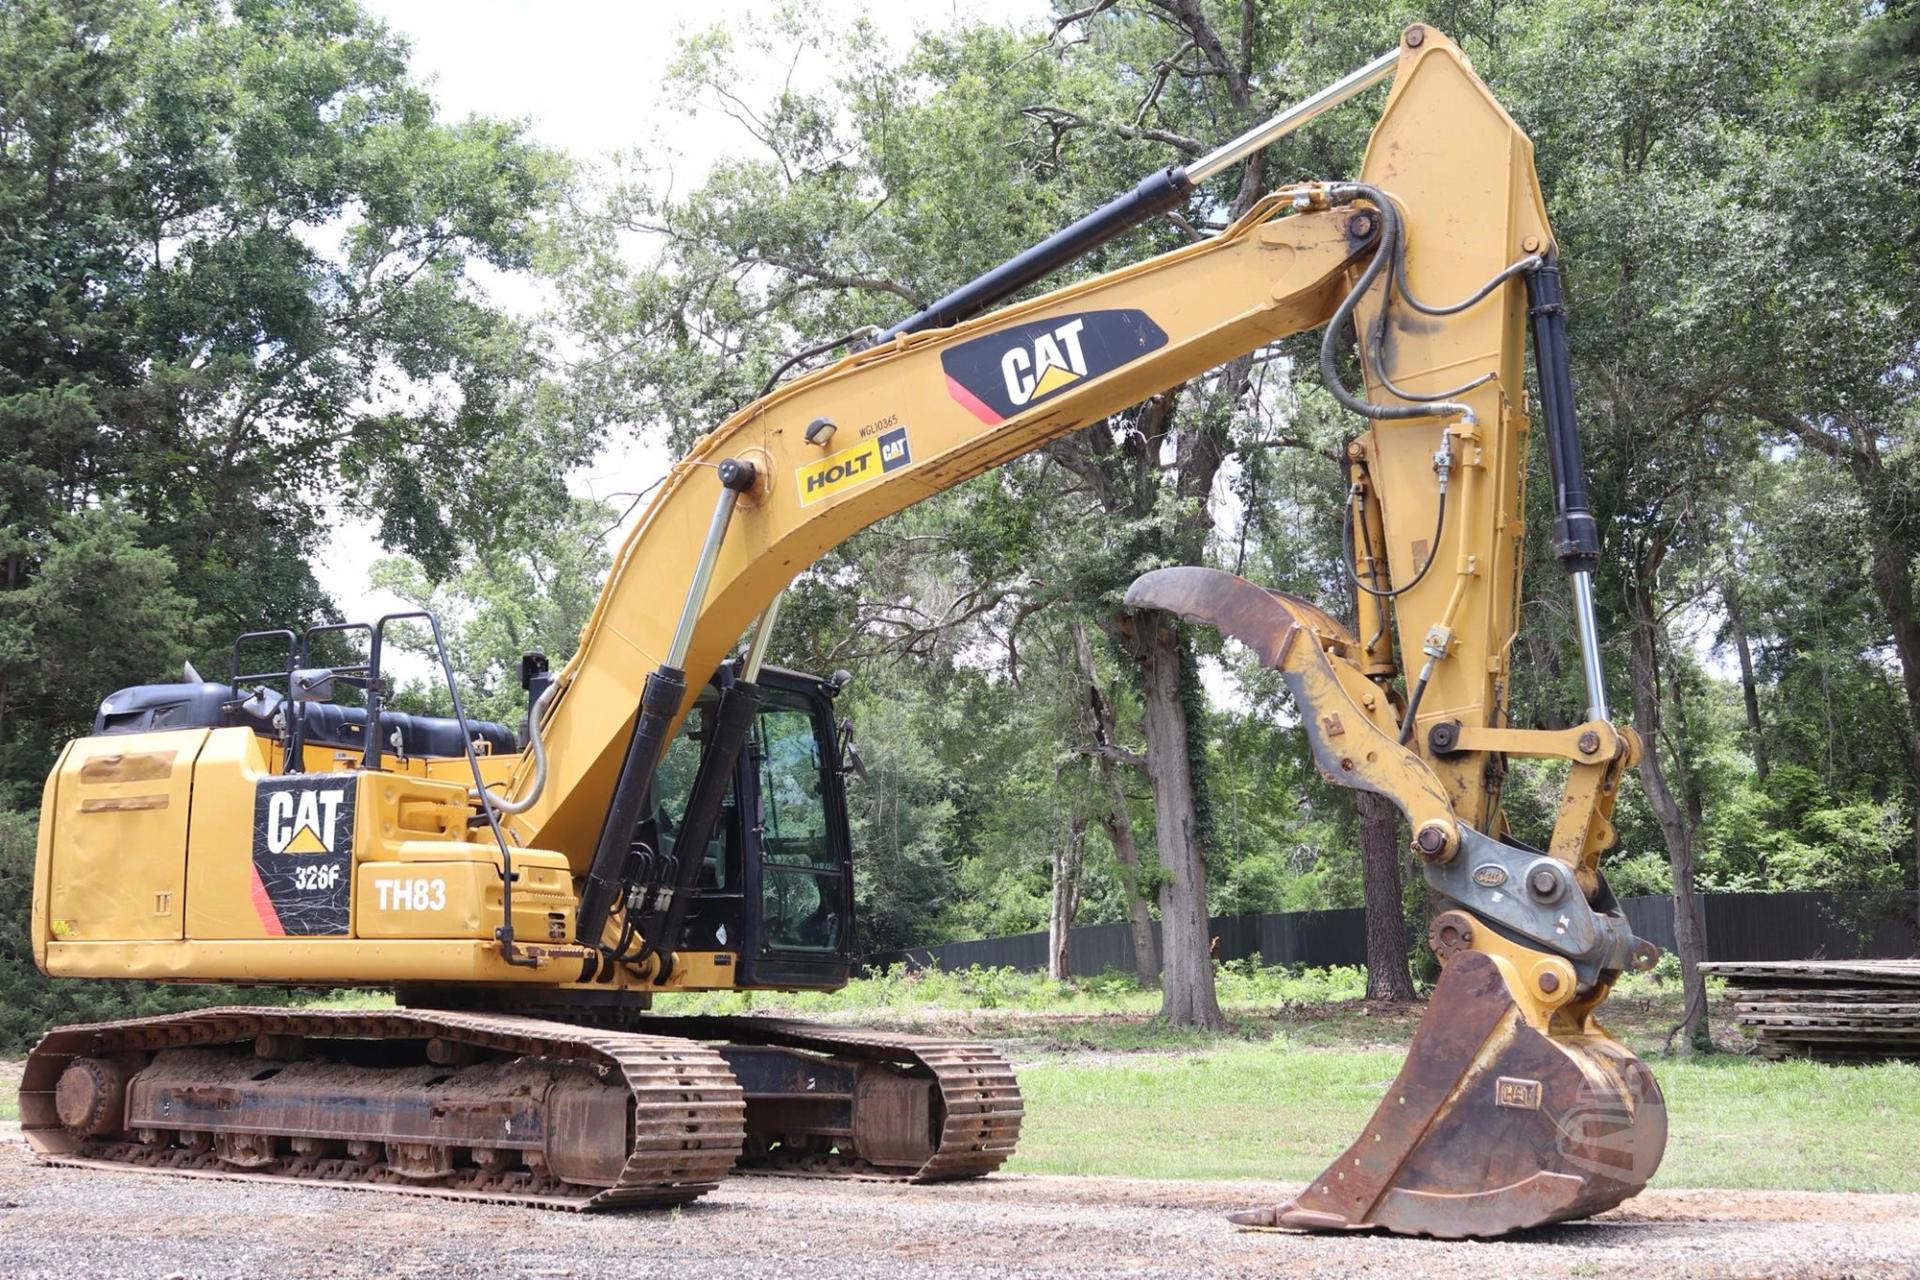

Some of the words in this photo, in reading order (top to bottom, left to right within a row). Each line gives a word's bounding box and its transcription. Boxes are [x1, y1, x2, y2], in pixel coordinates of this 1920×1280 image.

[1001, 318, 1088, 406] CAT
[807, 450, 872, 493] HOLT
[882, 438, 906, 462] CAT
[267, 790, 344, 854] CAT
[295, 865, 340, 890] 326F
[375, 879, 446, 911] TH83
[1501, 1083, 1536, 1108] CAT
